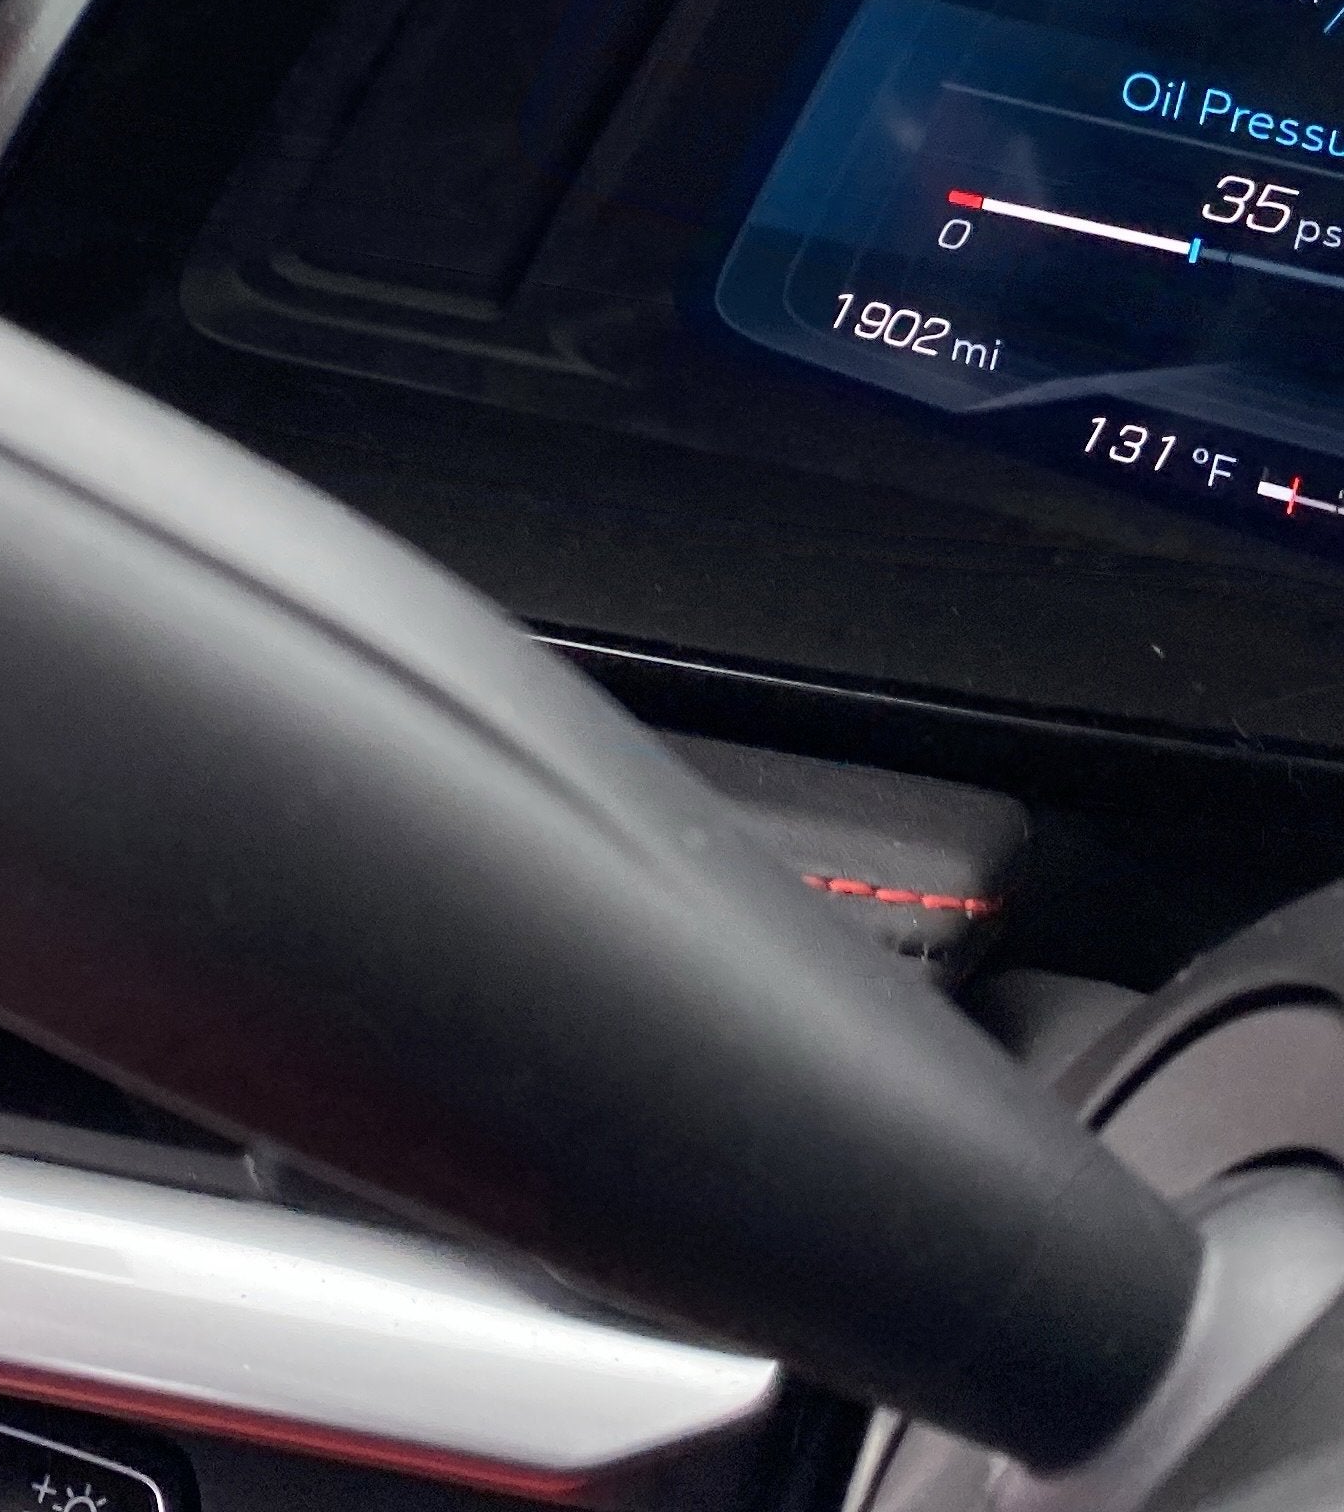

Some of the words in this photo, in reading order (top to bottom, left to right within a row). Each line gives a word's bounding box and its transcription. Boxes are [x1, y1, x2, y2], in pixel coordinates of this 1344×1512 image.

[1122, 71, 1186, 120] Oil
[937, 218, 972, 250] 0
[1084, 417, 1178, 472] 131
